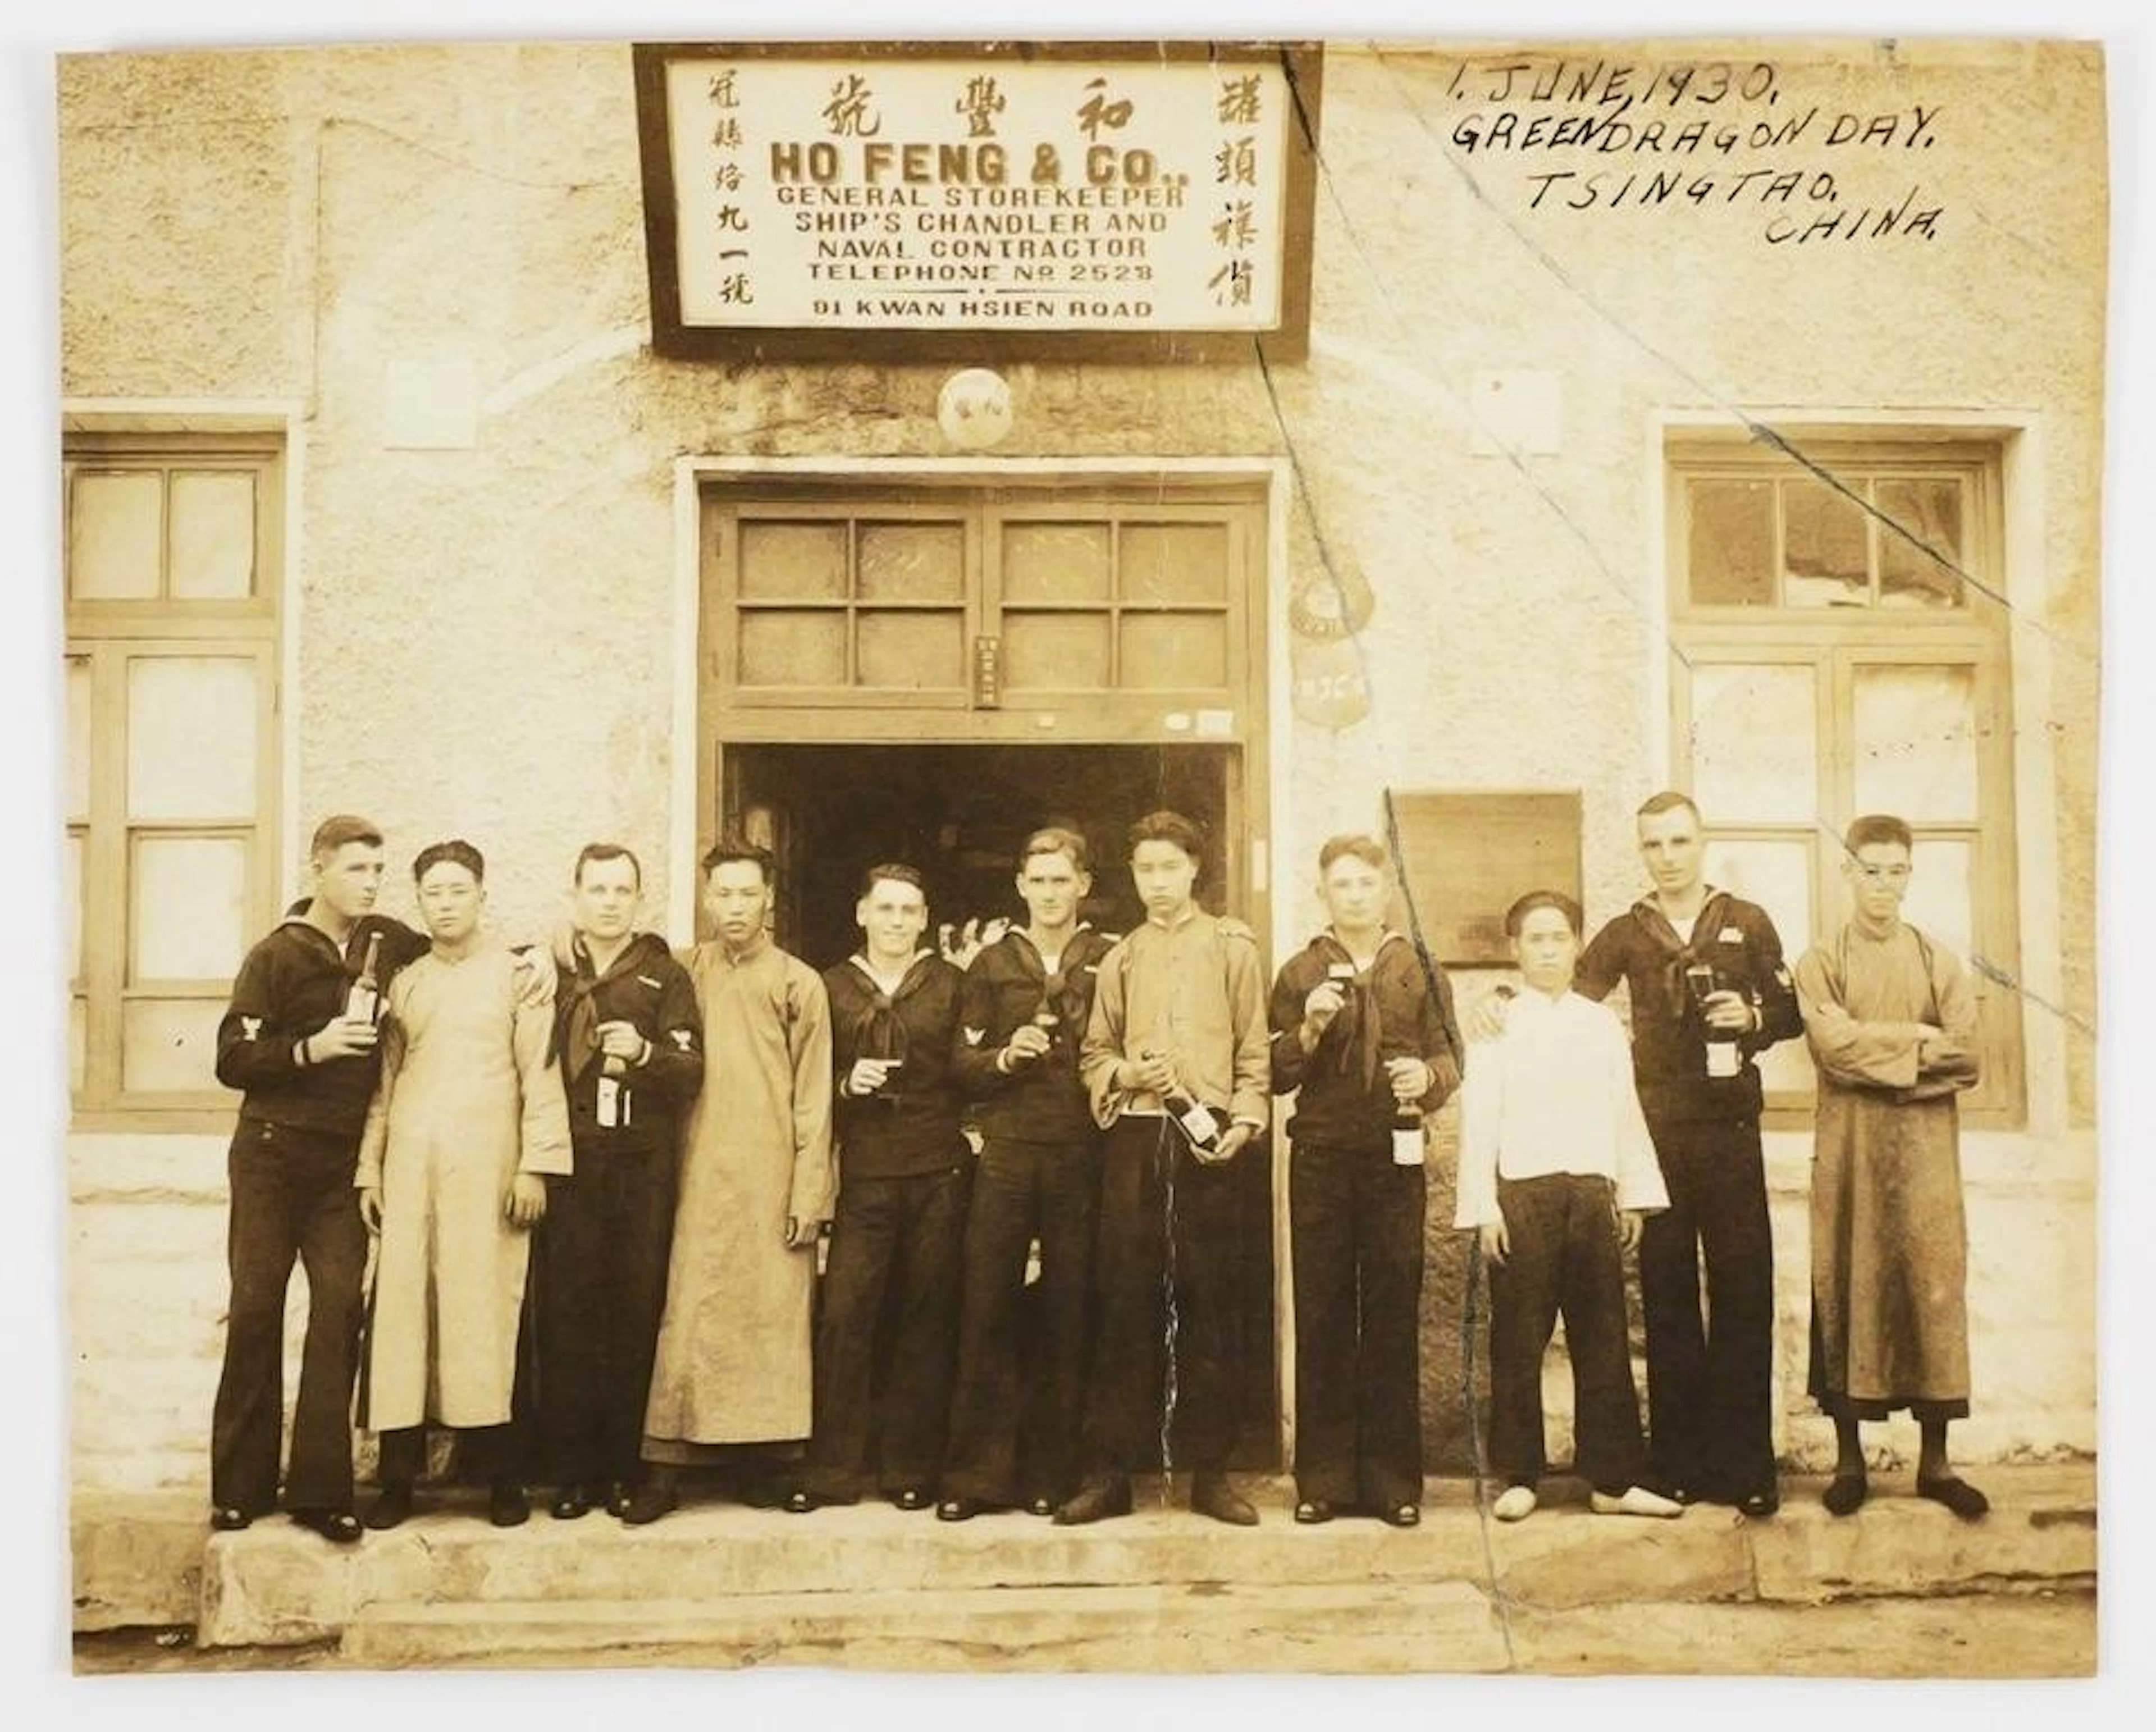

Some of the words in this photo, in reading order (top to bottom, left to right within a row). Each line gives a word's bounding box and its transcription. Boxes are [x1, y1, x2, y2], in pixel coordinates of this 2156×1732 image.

[770, 142, 839, 182] HO
[864, 144, 1006, 184] FENG
[1031, 143, 1060, 183] &
[776, 186, 930, 206] GENERAL
[943, 187, 1184, 208] STOREKEEPER
[795, 211, 902, 234] SHIP'S
[917, 212, 1090, 235] CHANDLER
[1106, 212, 1167, 232] AND
[817, 240, 915, 259] NAVAL
[930, 237, 1147, 258] CONTRACTOR
[808, 263, 1001, 281] TELEPHONE
[813, 300, 842, 315] 91
[856, 300, 945, 316] KWAN
[960, 300, 1055, 317] HSIEN
[1068, 300, 1154, 317] ROAD
